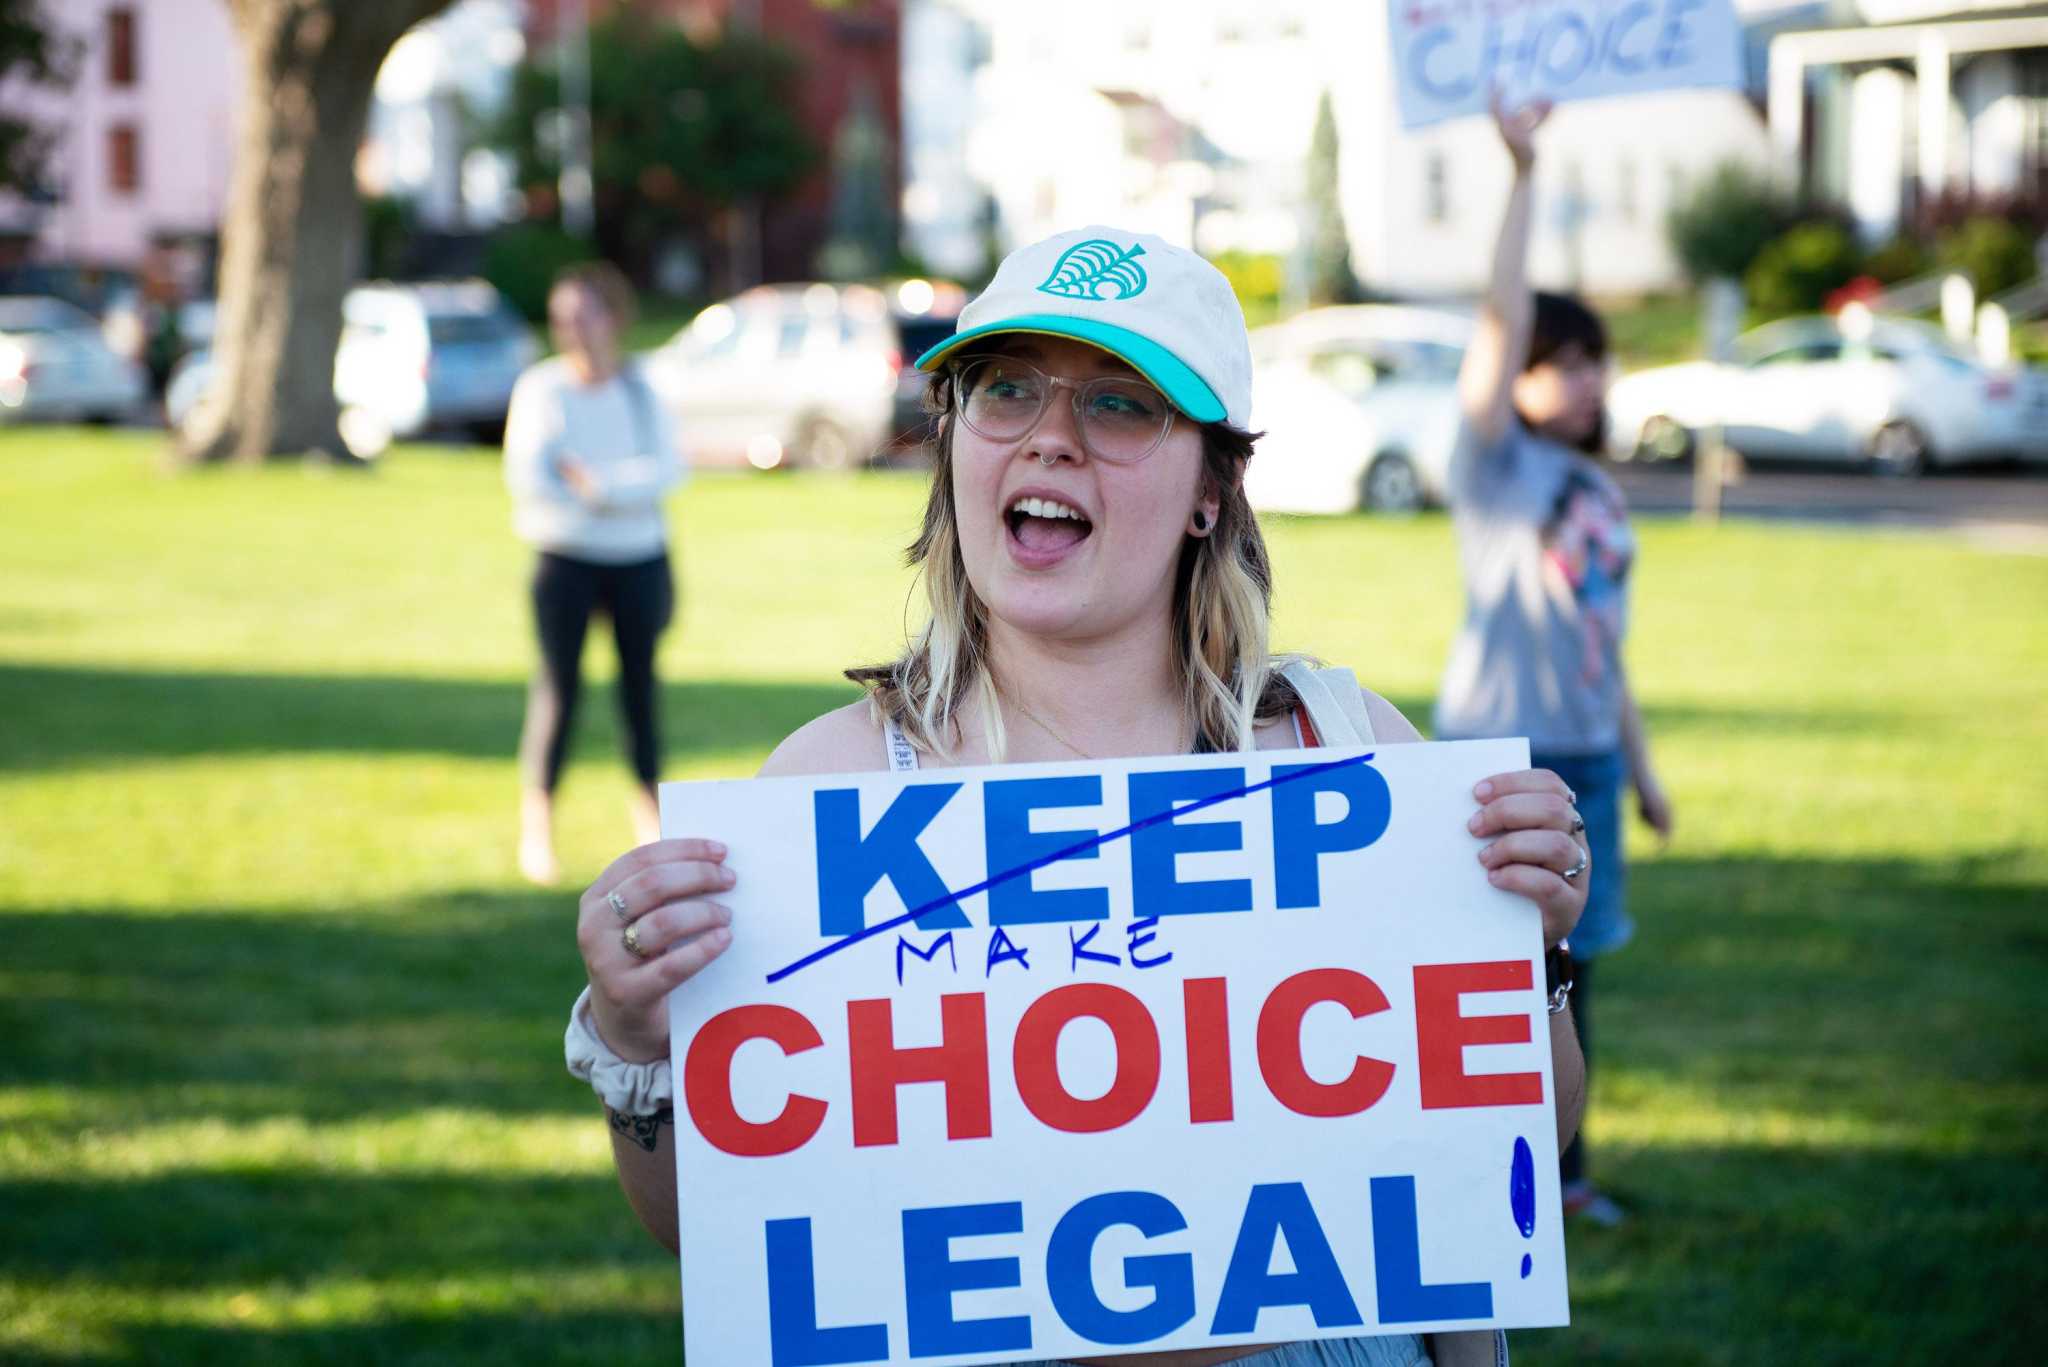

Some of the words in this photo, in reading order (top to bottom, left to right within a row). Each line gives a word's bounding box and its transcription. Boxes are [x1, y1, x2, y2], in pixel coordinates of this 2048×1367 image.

[1408, 0, 1704, 98] CHOICE
[814, 761, 1391, 937] KEEP
[896, 915, 1173, 985] MAKE
[684, 960, 1544, 1158] CHOICE
